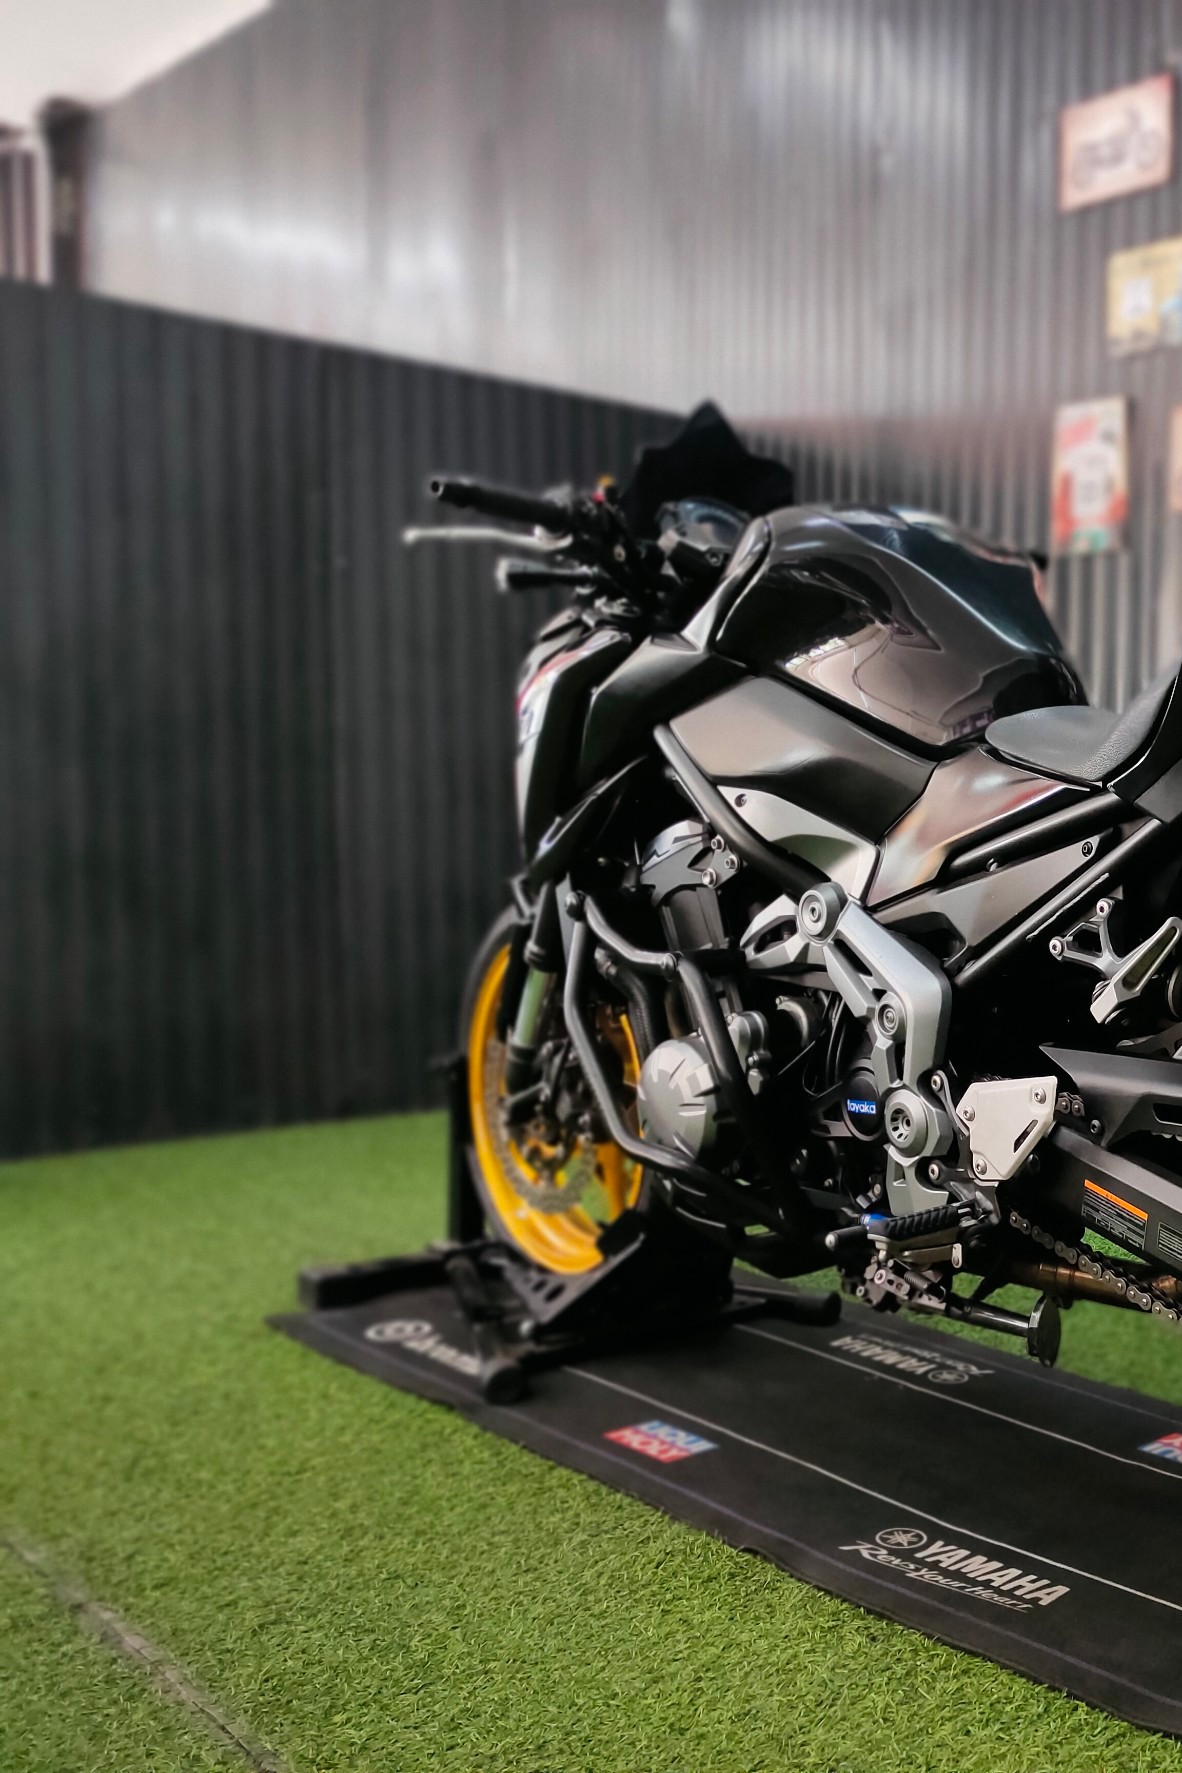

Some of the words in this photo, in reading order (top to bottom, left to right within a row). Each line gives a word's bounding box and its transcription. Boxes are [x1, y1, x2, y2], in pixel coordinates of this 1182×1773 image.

[847, 1099, 876, 1114] tayaka
[830, 1335, 937, 1375] YAMAHA
[838, 1540, 922, 1570] Revs
[905, 1567, 972, 1592] Your
[913, 1540, 1071, 1606] YAMAHA
